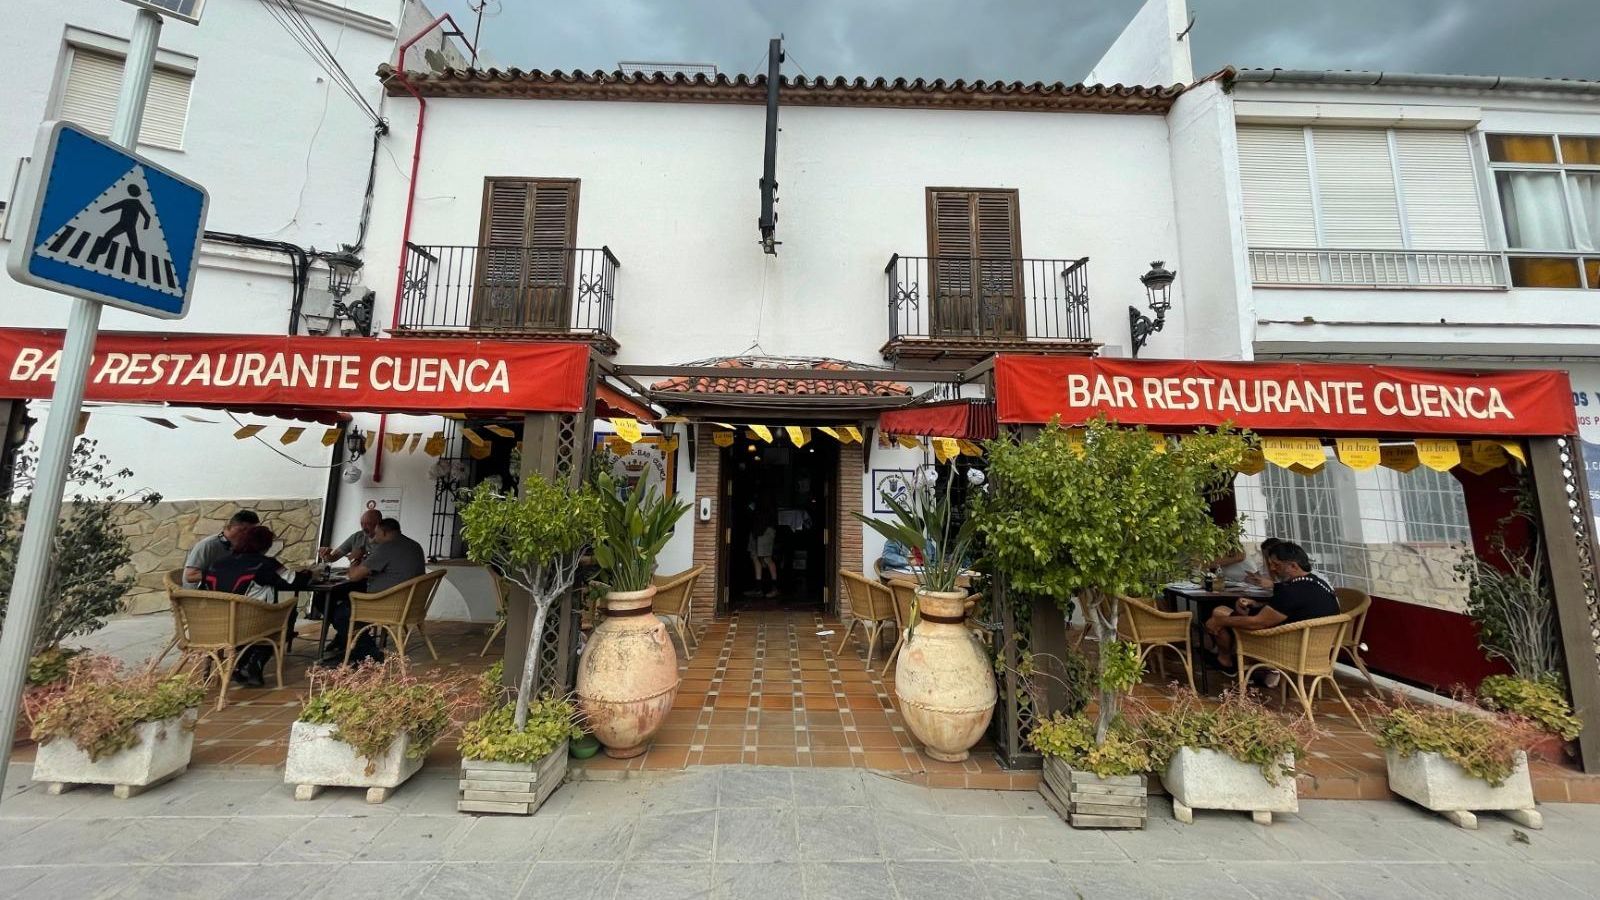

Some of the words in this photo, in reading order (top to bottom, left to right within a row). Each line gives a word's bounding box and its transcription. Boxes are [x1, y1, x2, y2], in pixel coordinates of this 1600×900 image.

[9, 347, 95, 382] BA
[93, 353, 361, 389] RESTAURANTE
[369, 355, 509, 393] CUENCA
[1067, 374, 1137, 408] BAR
[1143, 377, 1367, 414] RESTAURANTE
[1374, 382, 1514, 420] CUENCA
[1572, 392, 1588, 406] OS
